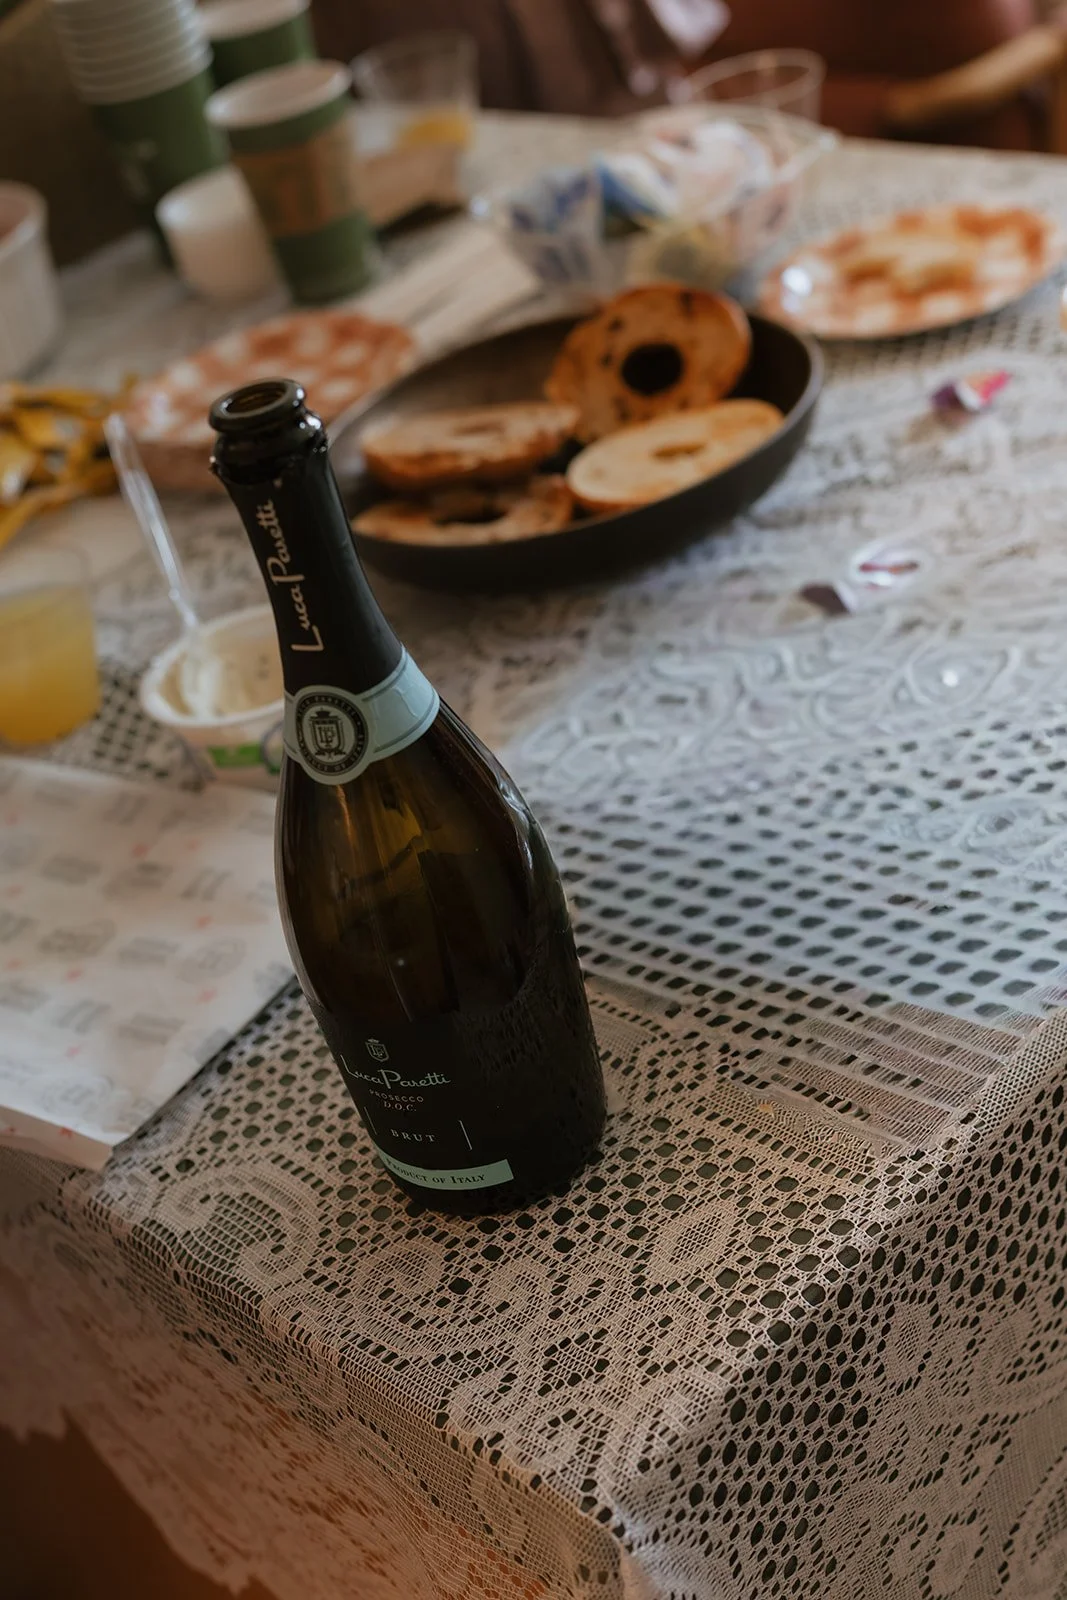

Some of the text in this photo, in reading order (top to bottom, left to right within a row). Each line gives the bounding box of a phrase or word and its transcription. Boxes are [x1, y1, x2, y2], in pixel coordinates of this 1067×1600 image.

[255, 498, 325, 651] Luca Paretti
[339, 1053, 452, 1090] Luca Paretti
[368, 1088, 425, 1104] PROSECCO
[390, 1128, 436, 1143] BRUT
[451, 1173, 486, 1184] ITALY
